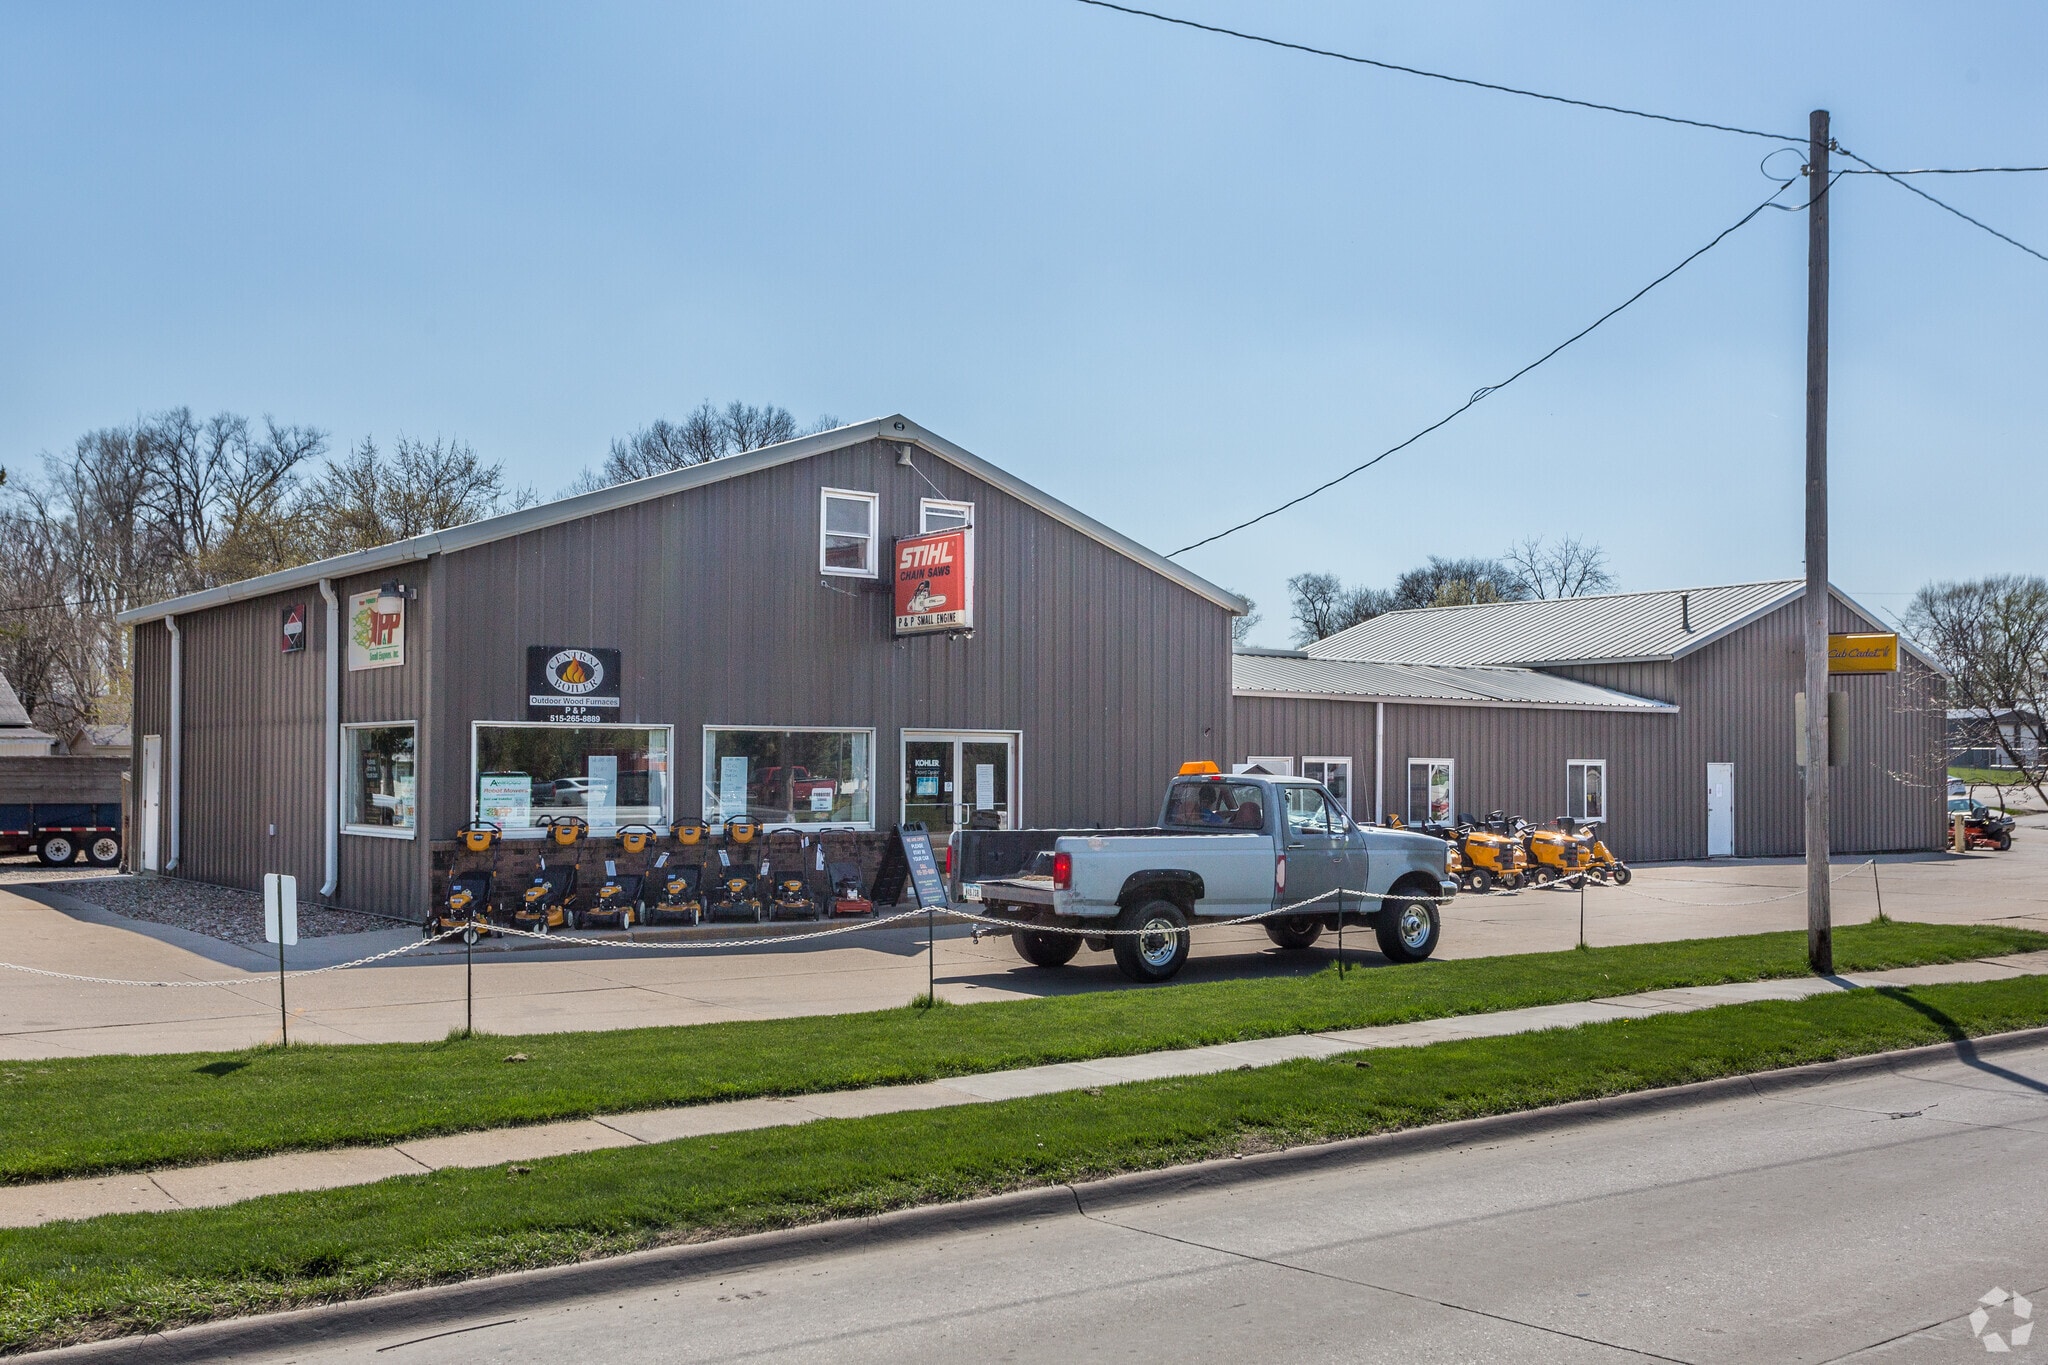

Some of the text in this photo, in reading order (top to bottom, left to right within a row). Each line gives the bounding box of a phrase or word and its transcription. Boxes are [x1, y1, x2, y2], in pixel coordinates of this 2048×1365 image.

[899, 541, 953, 569] STIHL
[900, 565, 951, 582] CHAIN SAWS
[898, 612, 956, 627] P & P SMALL ENGINE
[1828, 648, 1880, 658] Cub Cadet
[549, 652, 600, 671] CENTRAL
[554, 678, 599, 693] BOILER
[531, 697, 618, 706] Outdoor Wood Furnaces
[550, 715, 601, 723] 515-265-8889
[914, 759, 940, 767] KOHLER
